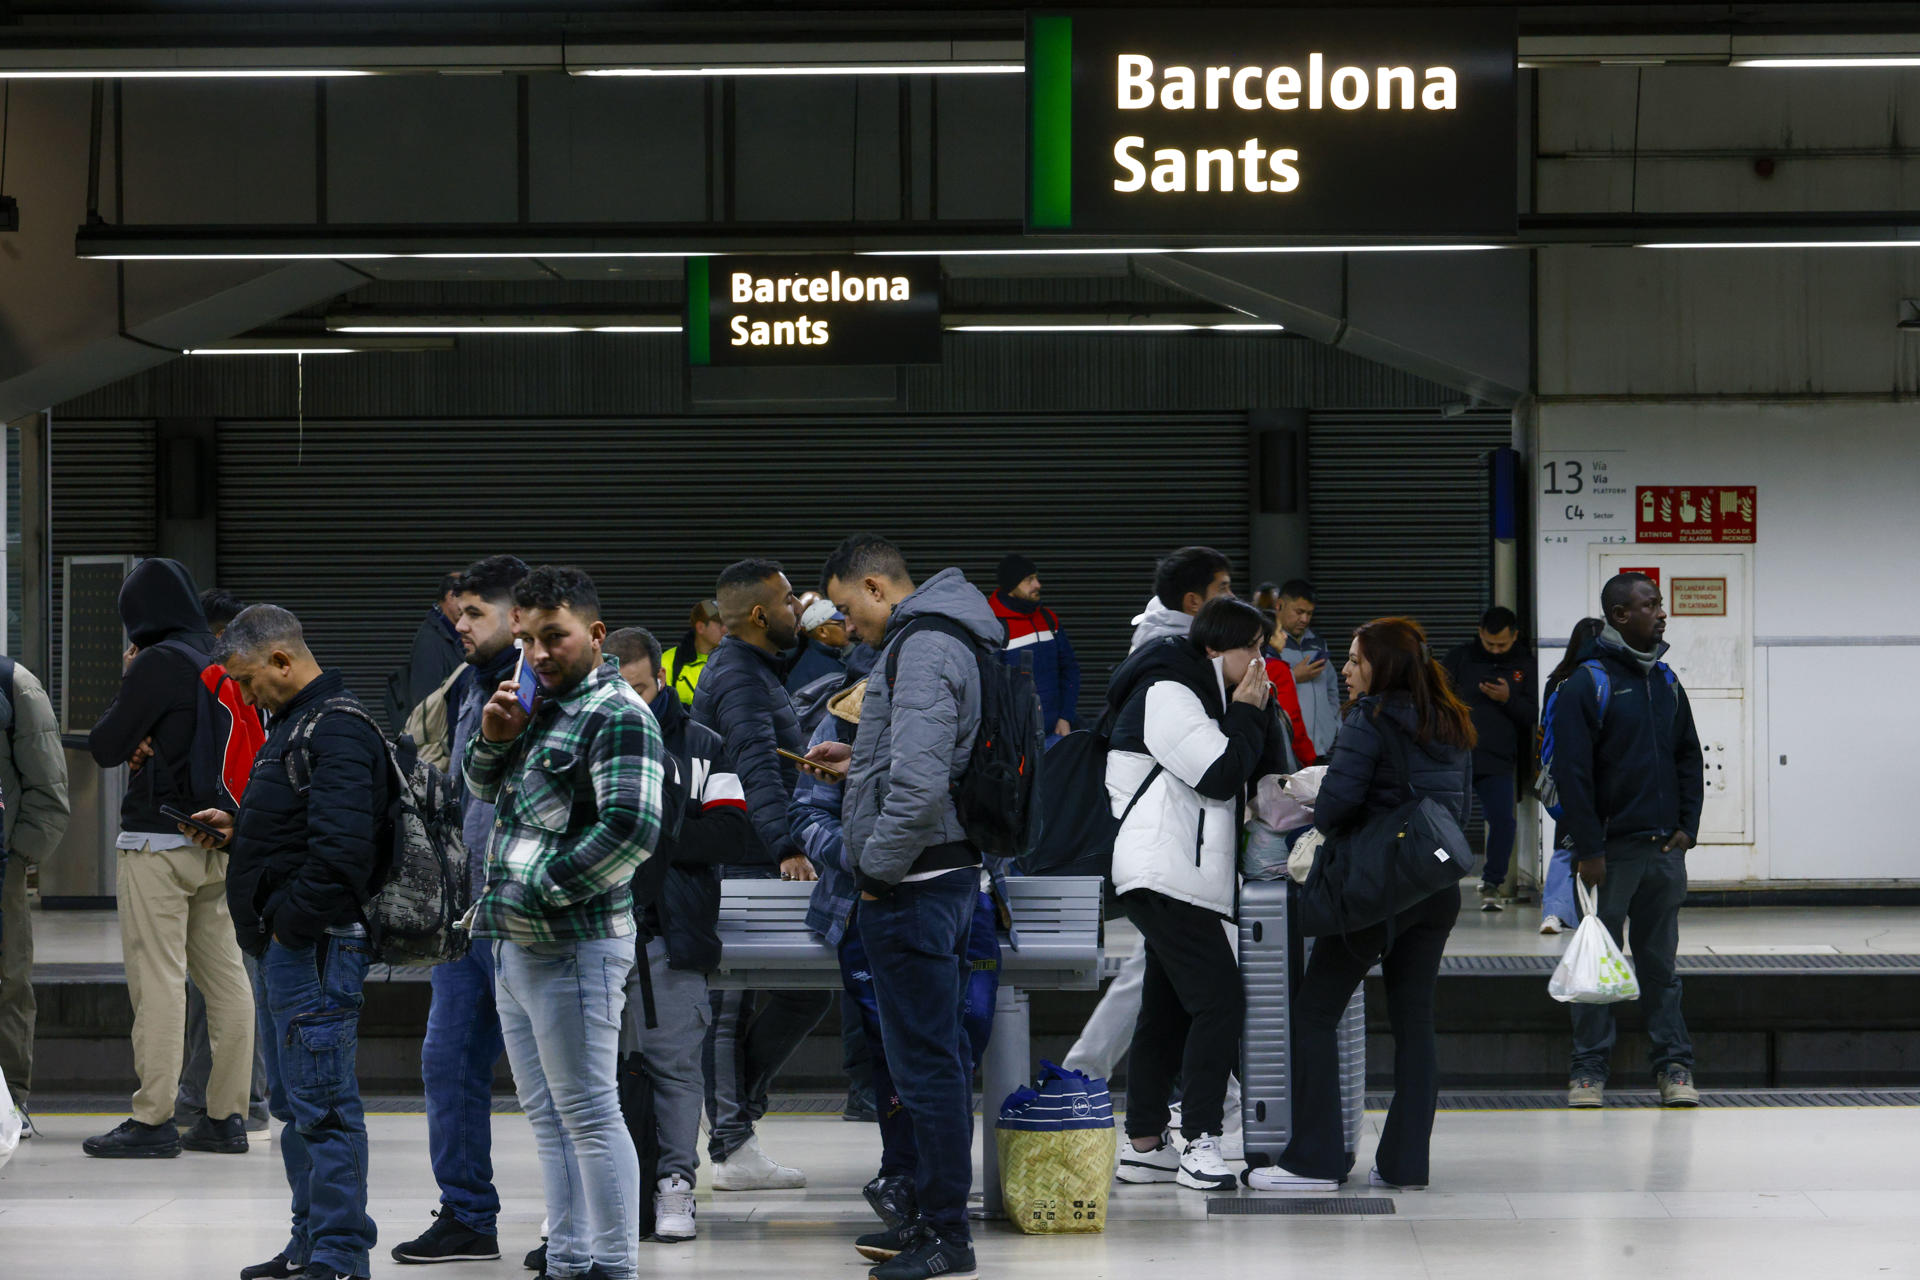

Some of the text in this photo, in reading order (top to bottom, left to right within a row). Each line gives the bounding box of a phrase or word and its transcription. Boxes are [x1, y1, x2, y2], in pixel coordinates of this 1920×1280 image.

[1118, 53, 1456, 110] Barcelona
[1114, 136, 1299, 192] Sants
[732, 271, 909, 302] Barcelona
[731, 316, 828, 345] Sants
[1543, 461, 1583, 495] 13
[1565, 504, 1584, 520] C4
